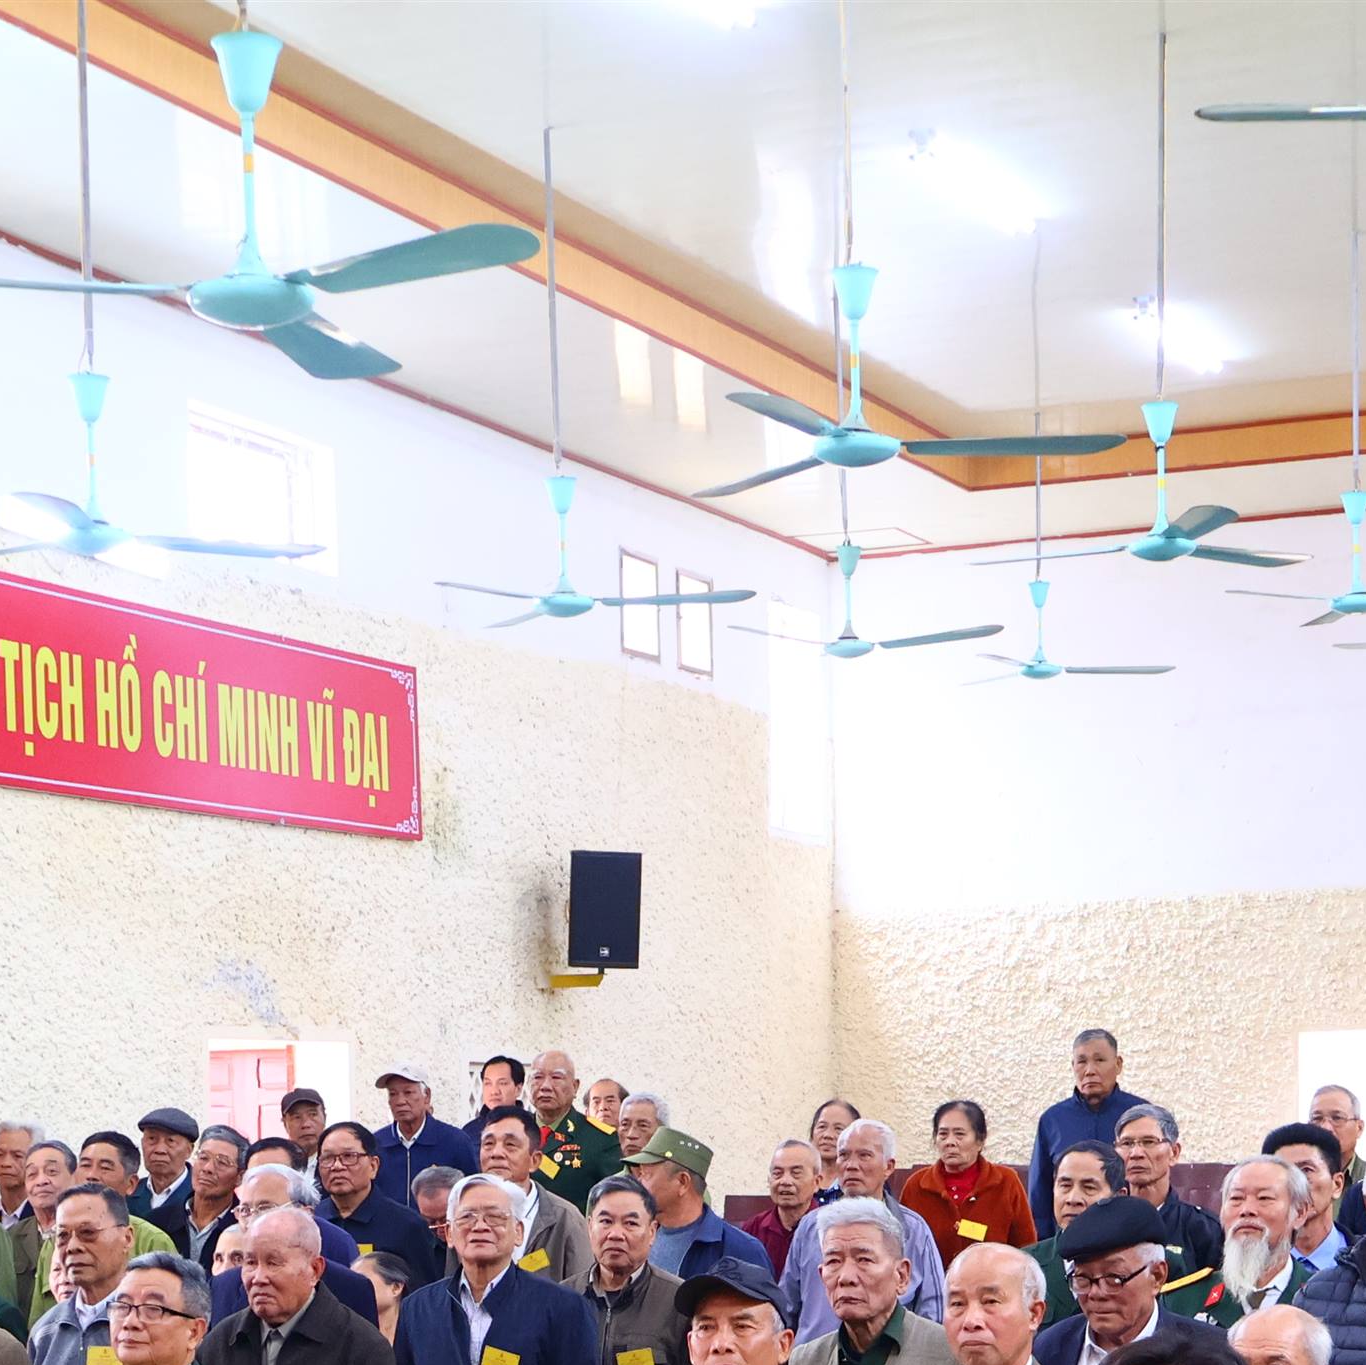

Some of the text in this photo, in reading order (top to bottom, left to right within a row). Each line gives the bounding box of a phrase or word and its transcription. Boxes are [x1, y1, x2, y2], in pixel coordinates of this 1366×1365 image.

[0, 638, 84, 756] TỊCH
[95, 634, 142, 752] HỒ
[153, 661, 208, 763] CHÍ
[218, 683, 299, 777] MINH
[307, 688, 335, 783] VĨ
[343, 708, 390, 808] ĐẠI
